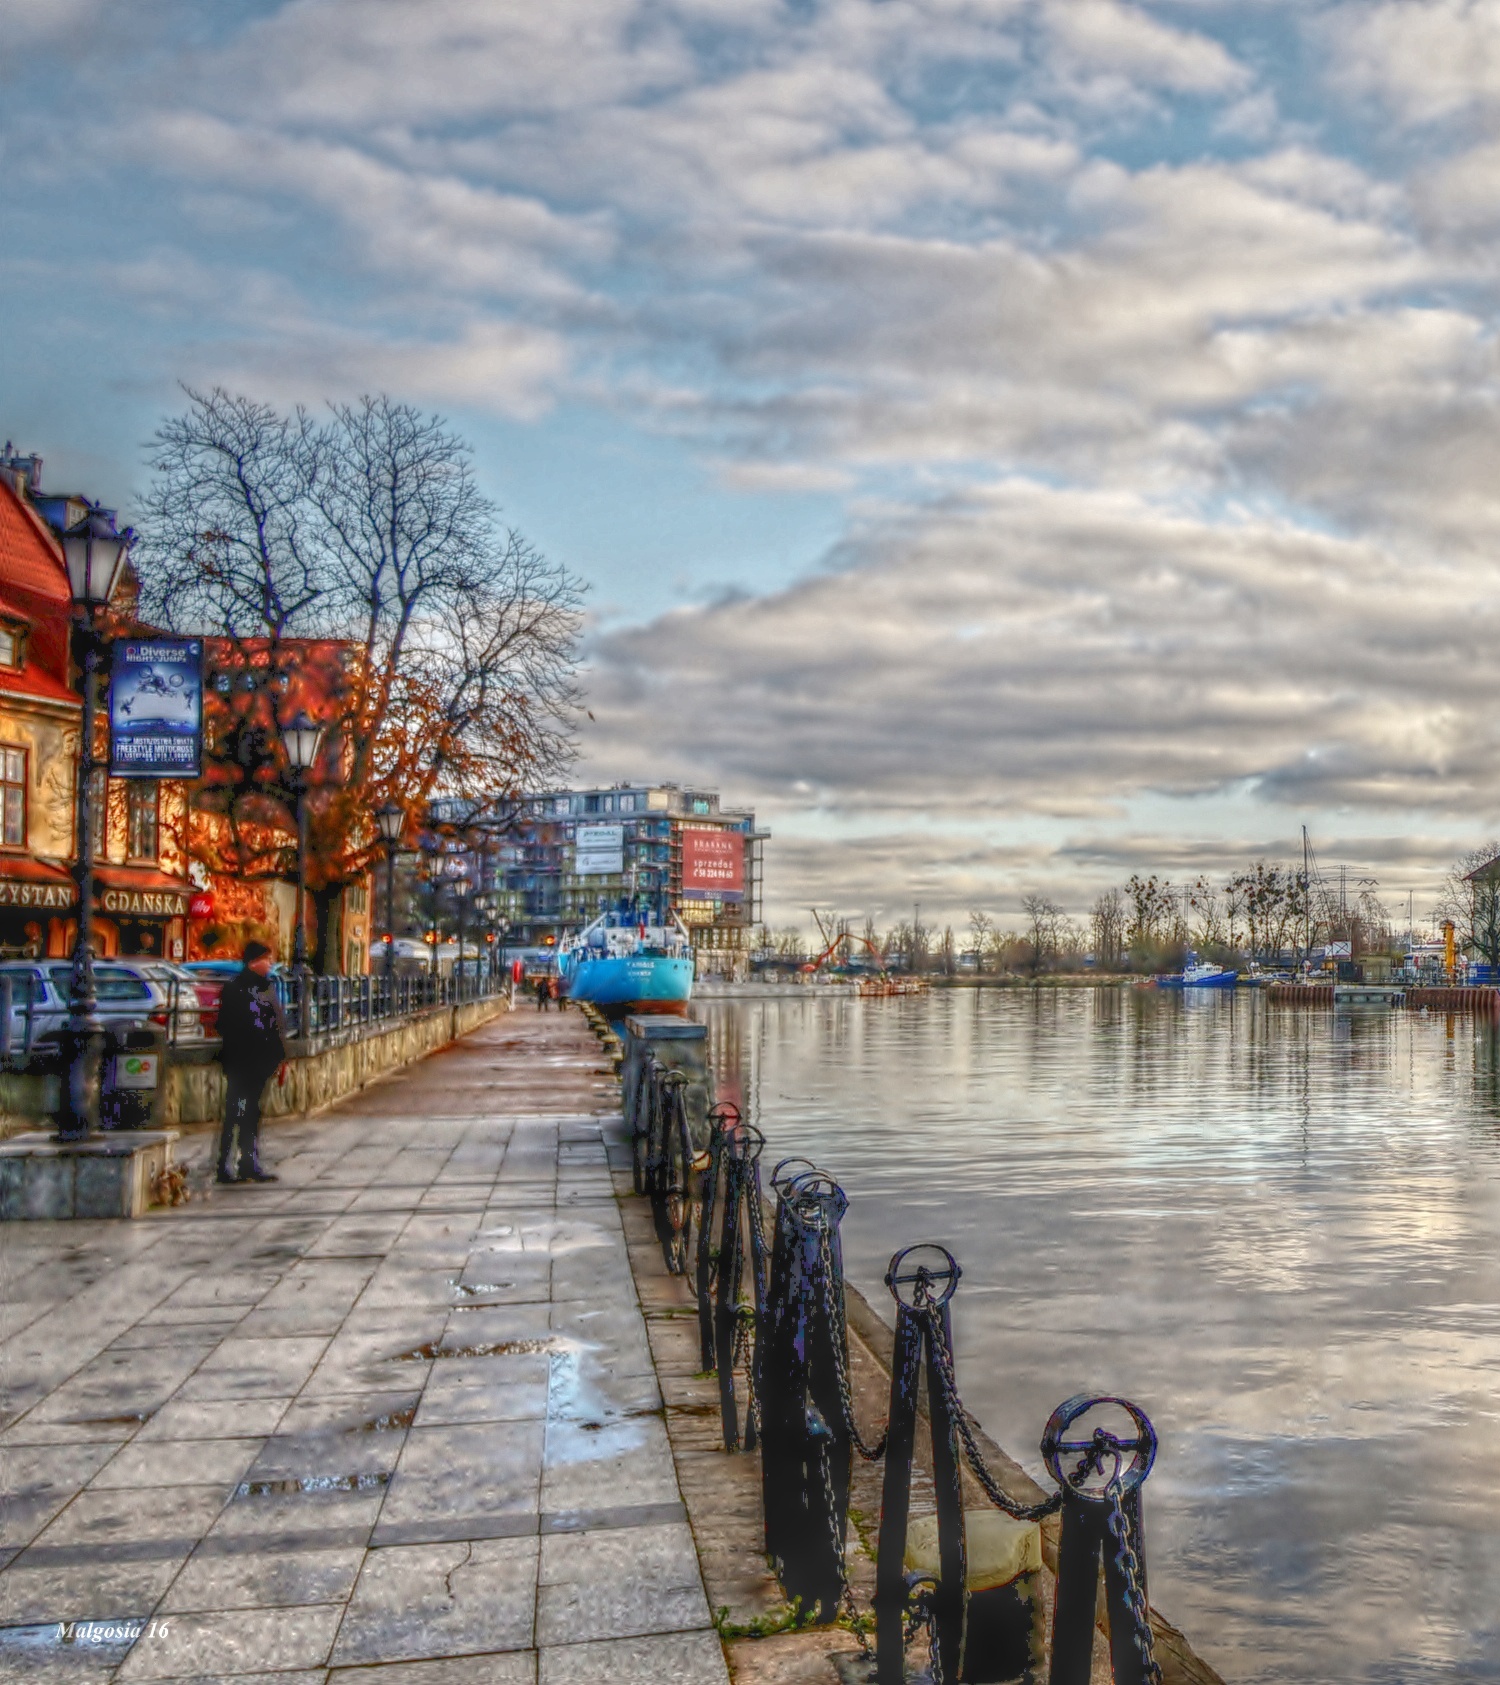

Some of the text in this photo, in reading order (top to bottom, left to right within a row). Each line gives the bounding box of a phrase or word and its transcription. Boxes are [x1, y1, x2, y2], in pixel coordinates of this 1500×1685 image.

[140, 646, 186, 657] Diverse
[133, 737, 172, 745] MISTRZOSTWA
[116, 745, 194, 753] FREESTYLE MOTOCROSS
